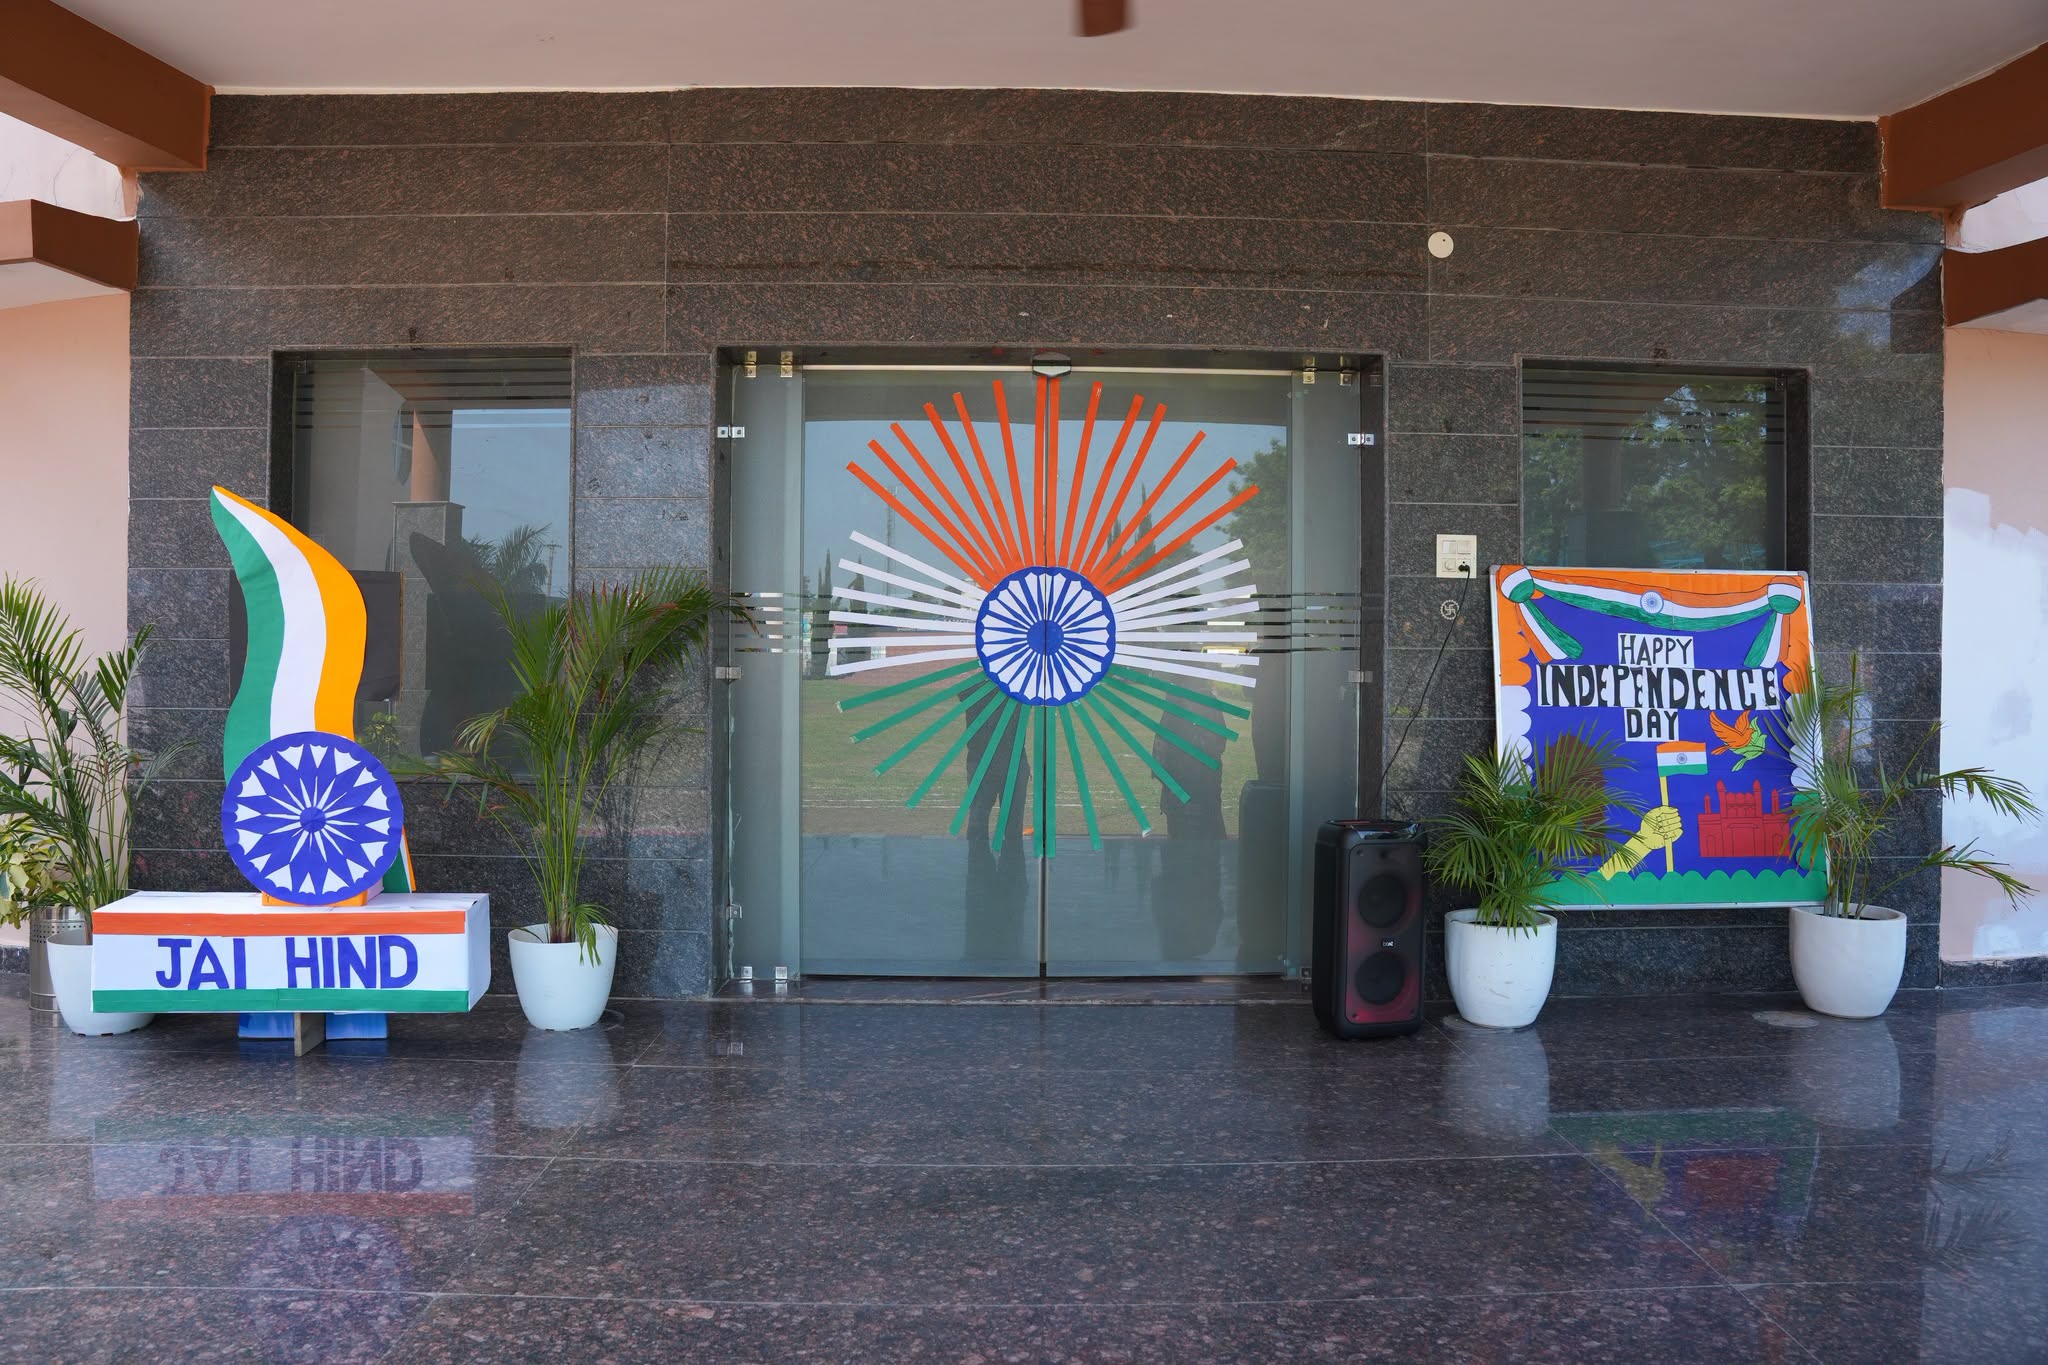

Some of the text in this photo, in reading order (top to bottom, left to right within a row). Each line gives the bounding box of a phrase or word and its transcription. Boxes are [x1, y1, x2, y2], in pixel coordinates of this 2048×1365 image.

[1620, 634, 1692, 665] HAPPY
[1539, 664, 1777, 710] INDEPENDENCE
[1627, 710, 1678, 740] DAY
[155, 935, 419, 990] JAI HIND
